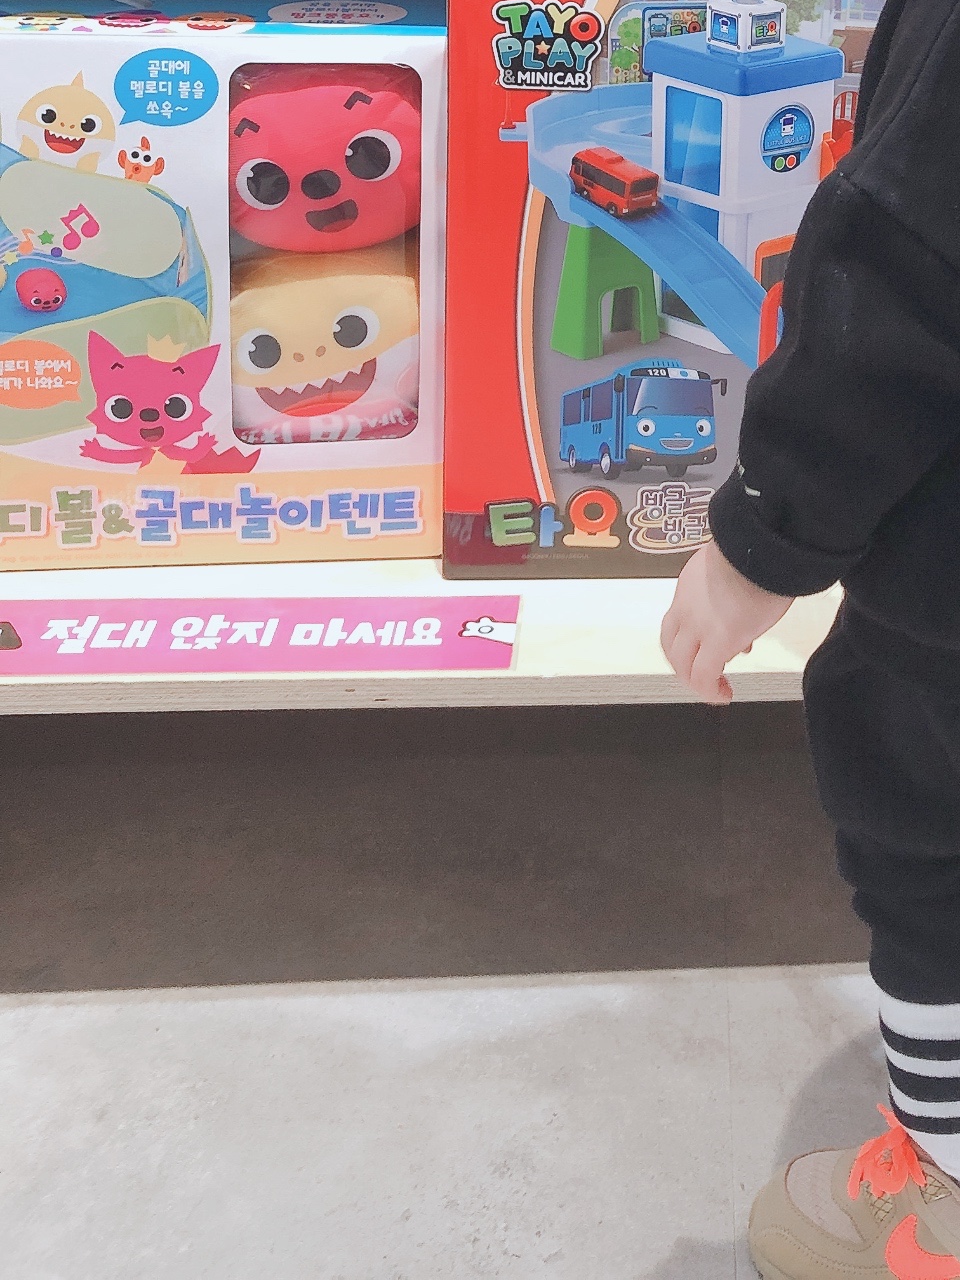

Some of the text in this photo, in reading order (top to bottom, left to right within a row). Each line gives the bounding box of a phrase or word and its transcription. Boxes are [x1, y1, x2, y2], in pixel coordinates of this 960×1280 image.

[499, 3, 599, 42] TAYO
[497, 37, 596, 71] PLAY
[147, 59, 191, 76] 골대에
[503, 69, 588, 86] & MINICAR
[130, 80, 206, 97] 멜로디 볼을
[34, 359, 72, 375] 볼에서
[647, 368, 667, 377] 120
[27, 376, 79, 390] 나와요~
[488, 489, 621, 549] 타요
[40, 613, 443, 655] 절대 앉지 마세요
